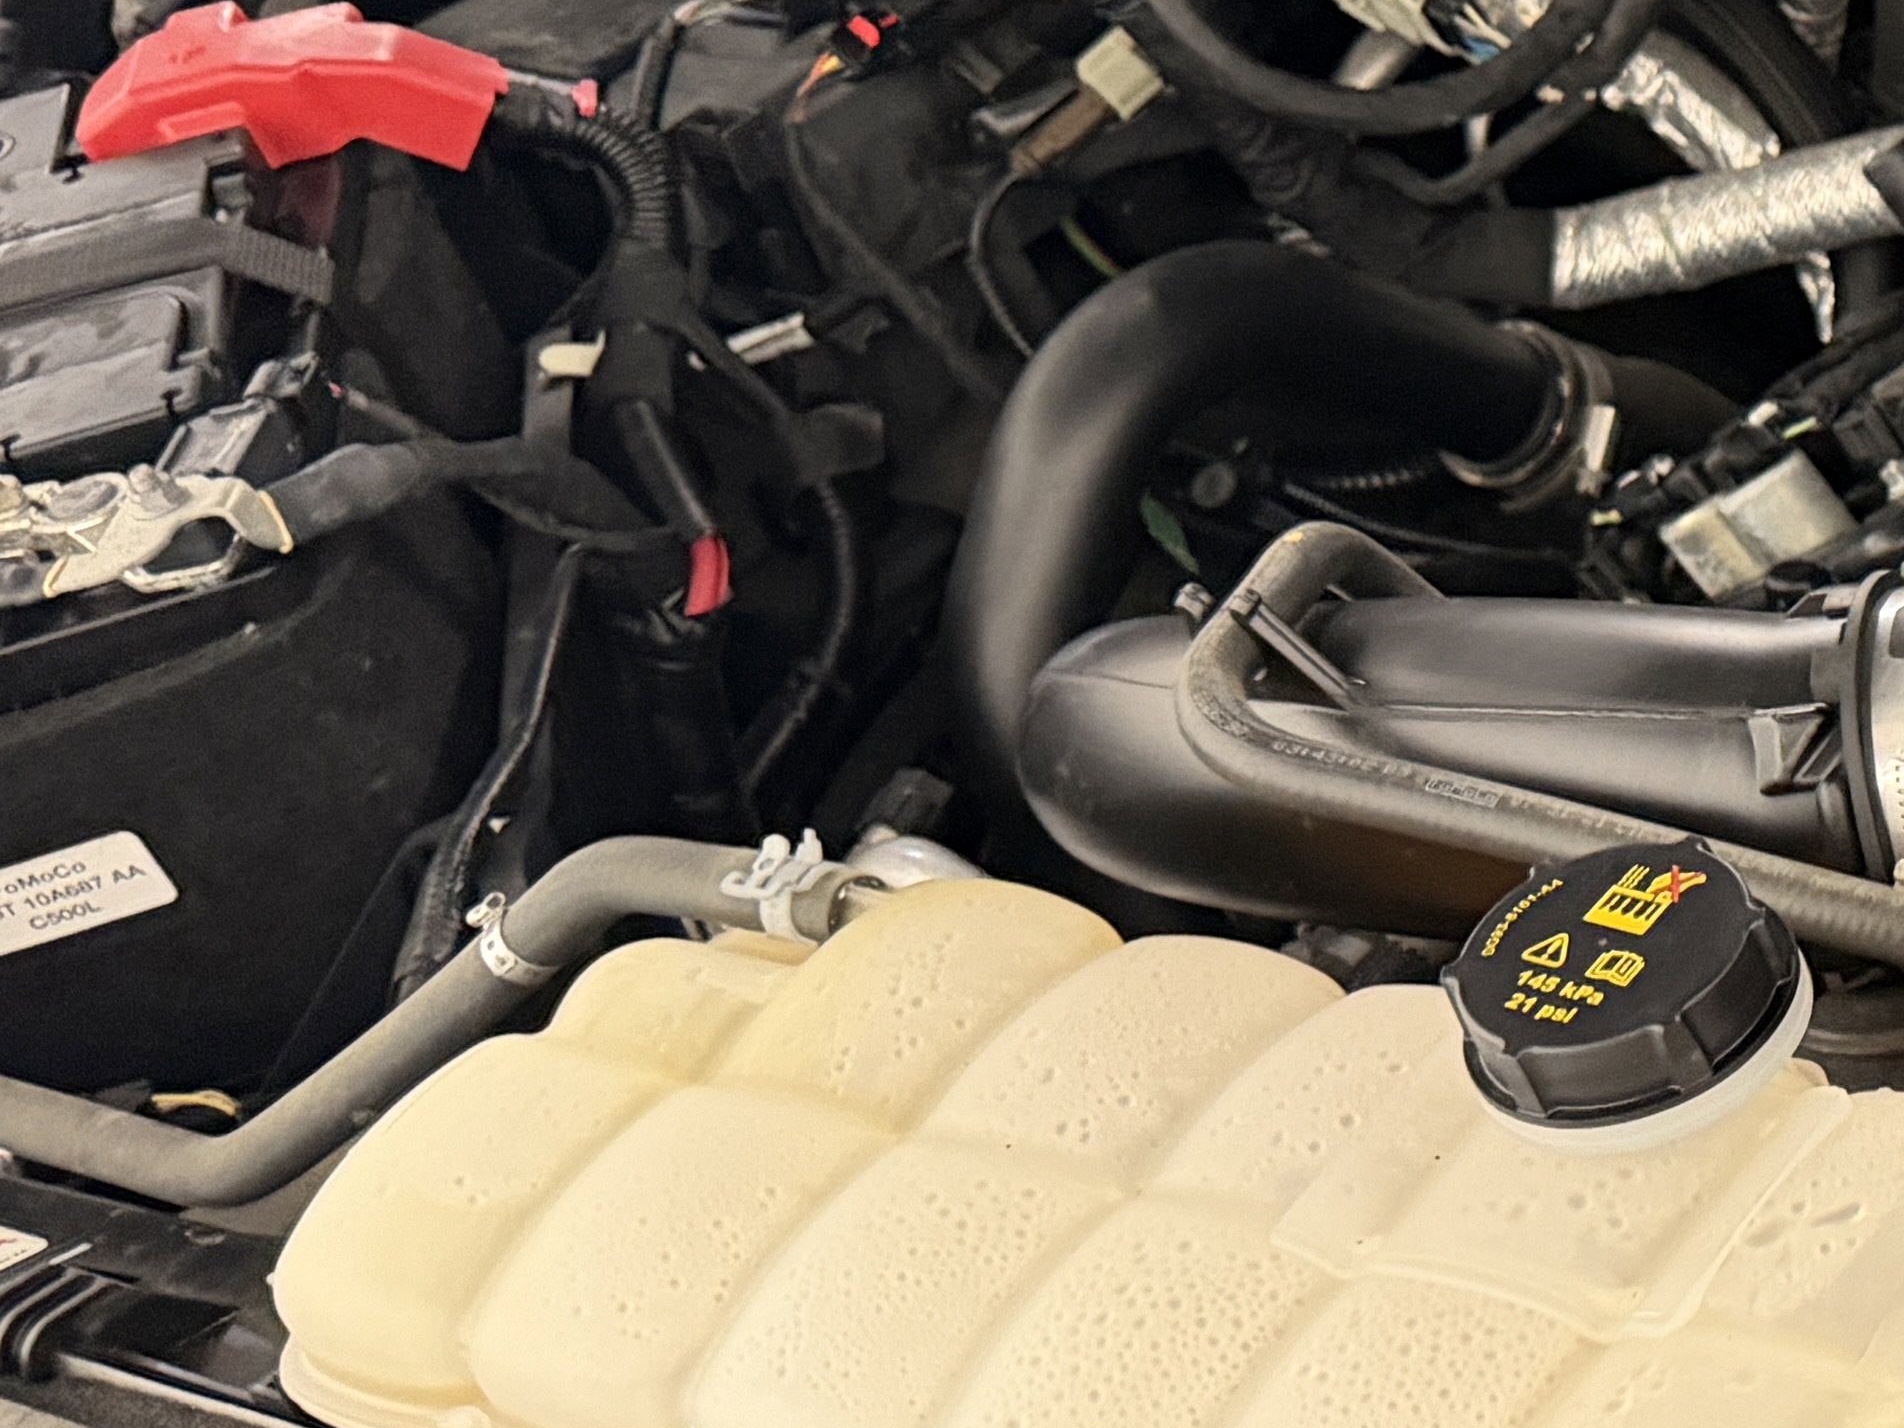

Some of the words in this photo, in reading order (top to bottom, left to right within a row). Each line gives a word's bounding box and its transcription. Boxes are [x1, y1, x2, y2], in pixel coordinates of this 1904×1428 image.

[0, 861, 87, 894] oMoCo
[111, 864, 147, 884] AA
[29, 900, 103, 930] C500L
[1516, 970, 1558, 994] 145
[1559, 980, 1605, 1007] kPa
[1504, 992, 1537, 1014] 21
[1533, 1003, 1580, 1024] psi
